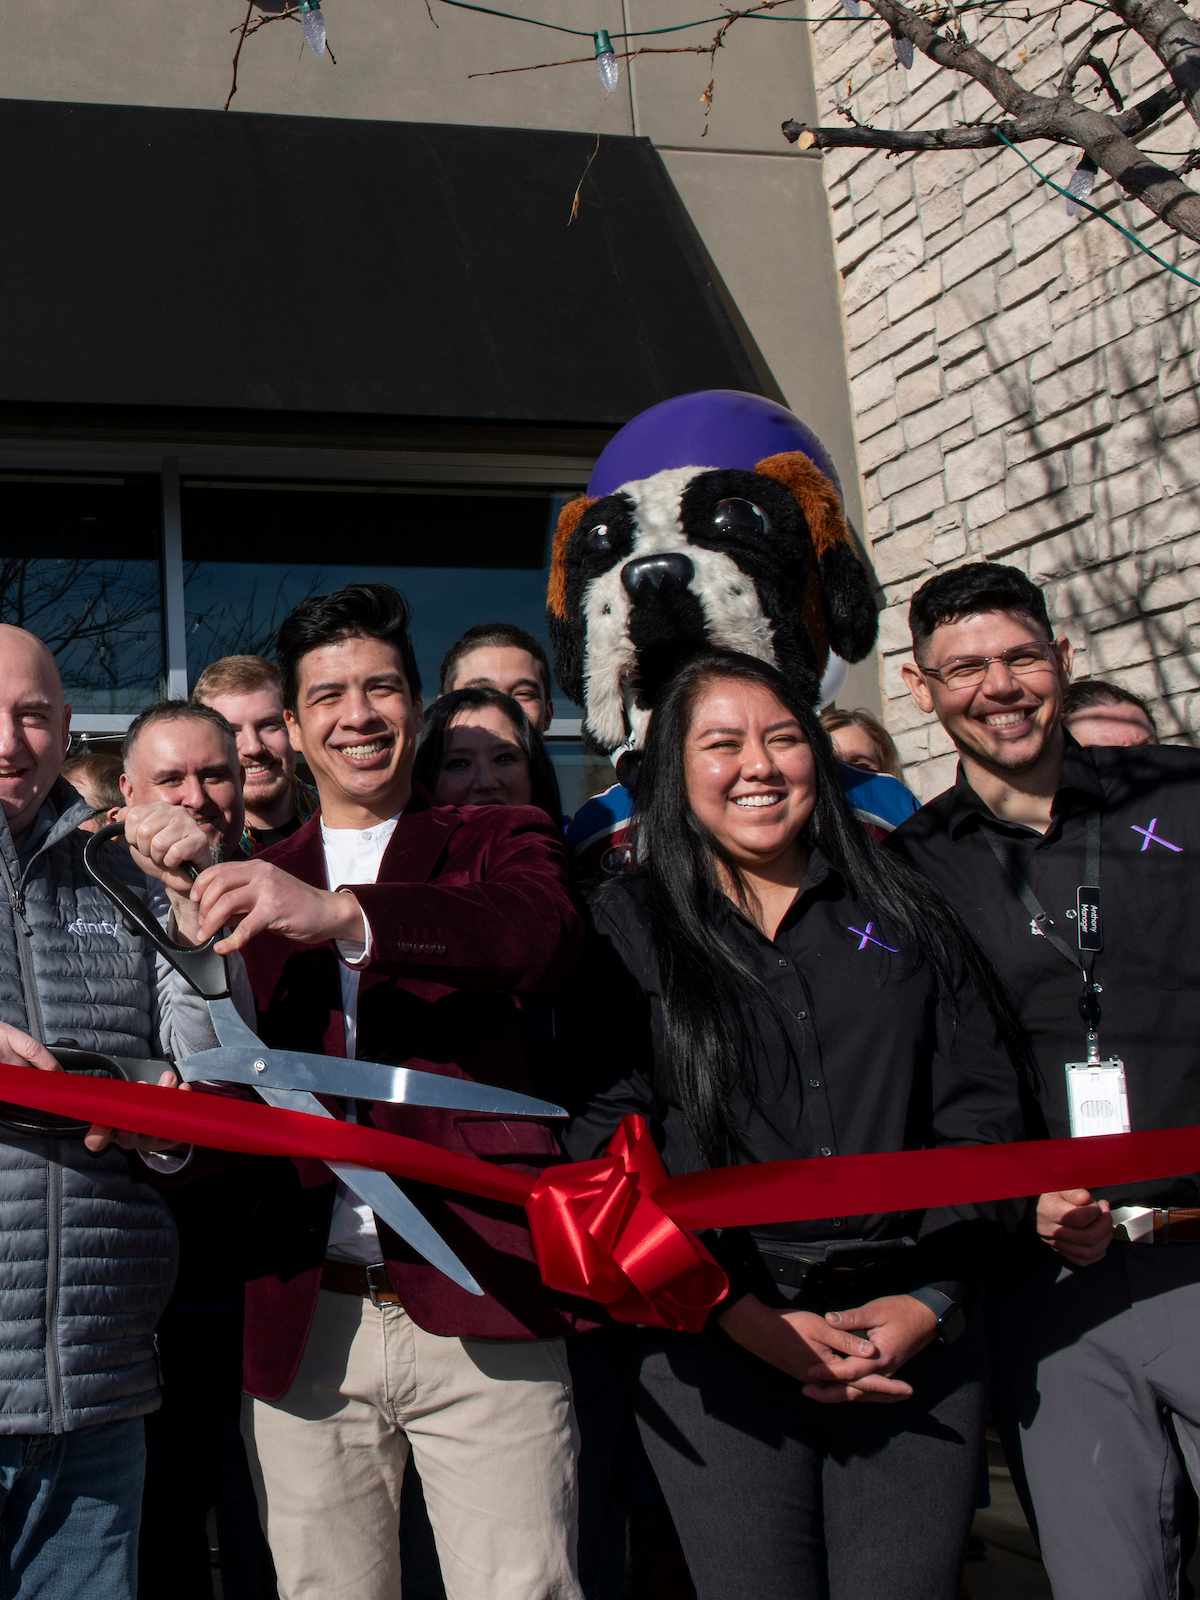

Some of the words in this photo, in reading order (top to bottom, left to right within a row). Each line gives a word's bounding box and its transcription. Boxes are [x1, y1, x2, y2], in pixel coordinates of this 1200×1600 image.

[67, 918, 118, 938] xfinity
[1080, 904, 1089, 933] Manager
[1090, 904, 1099, 933] Anthony
